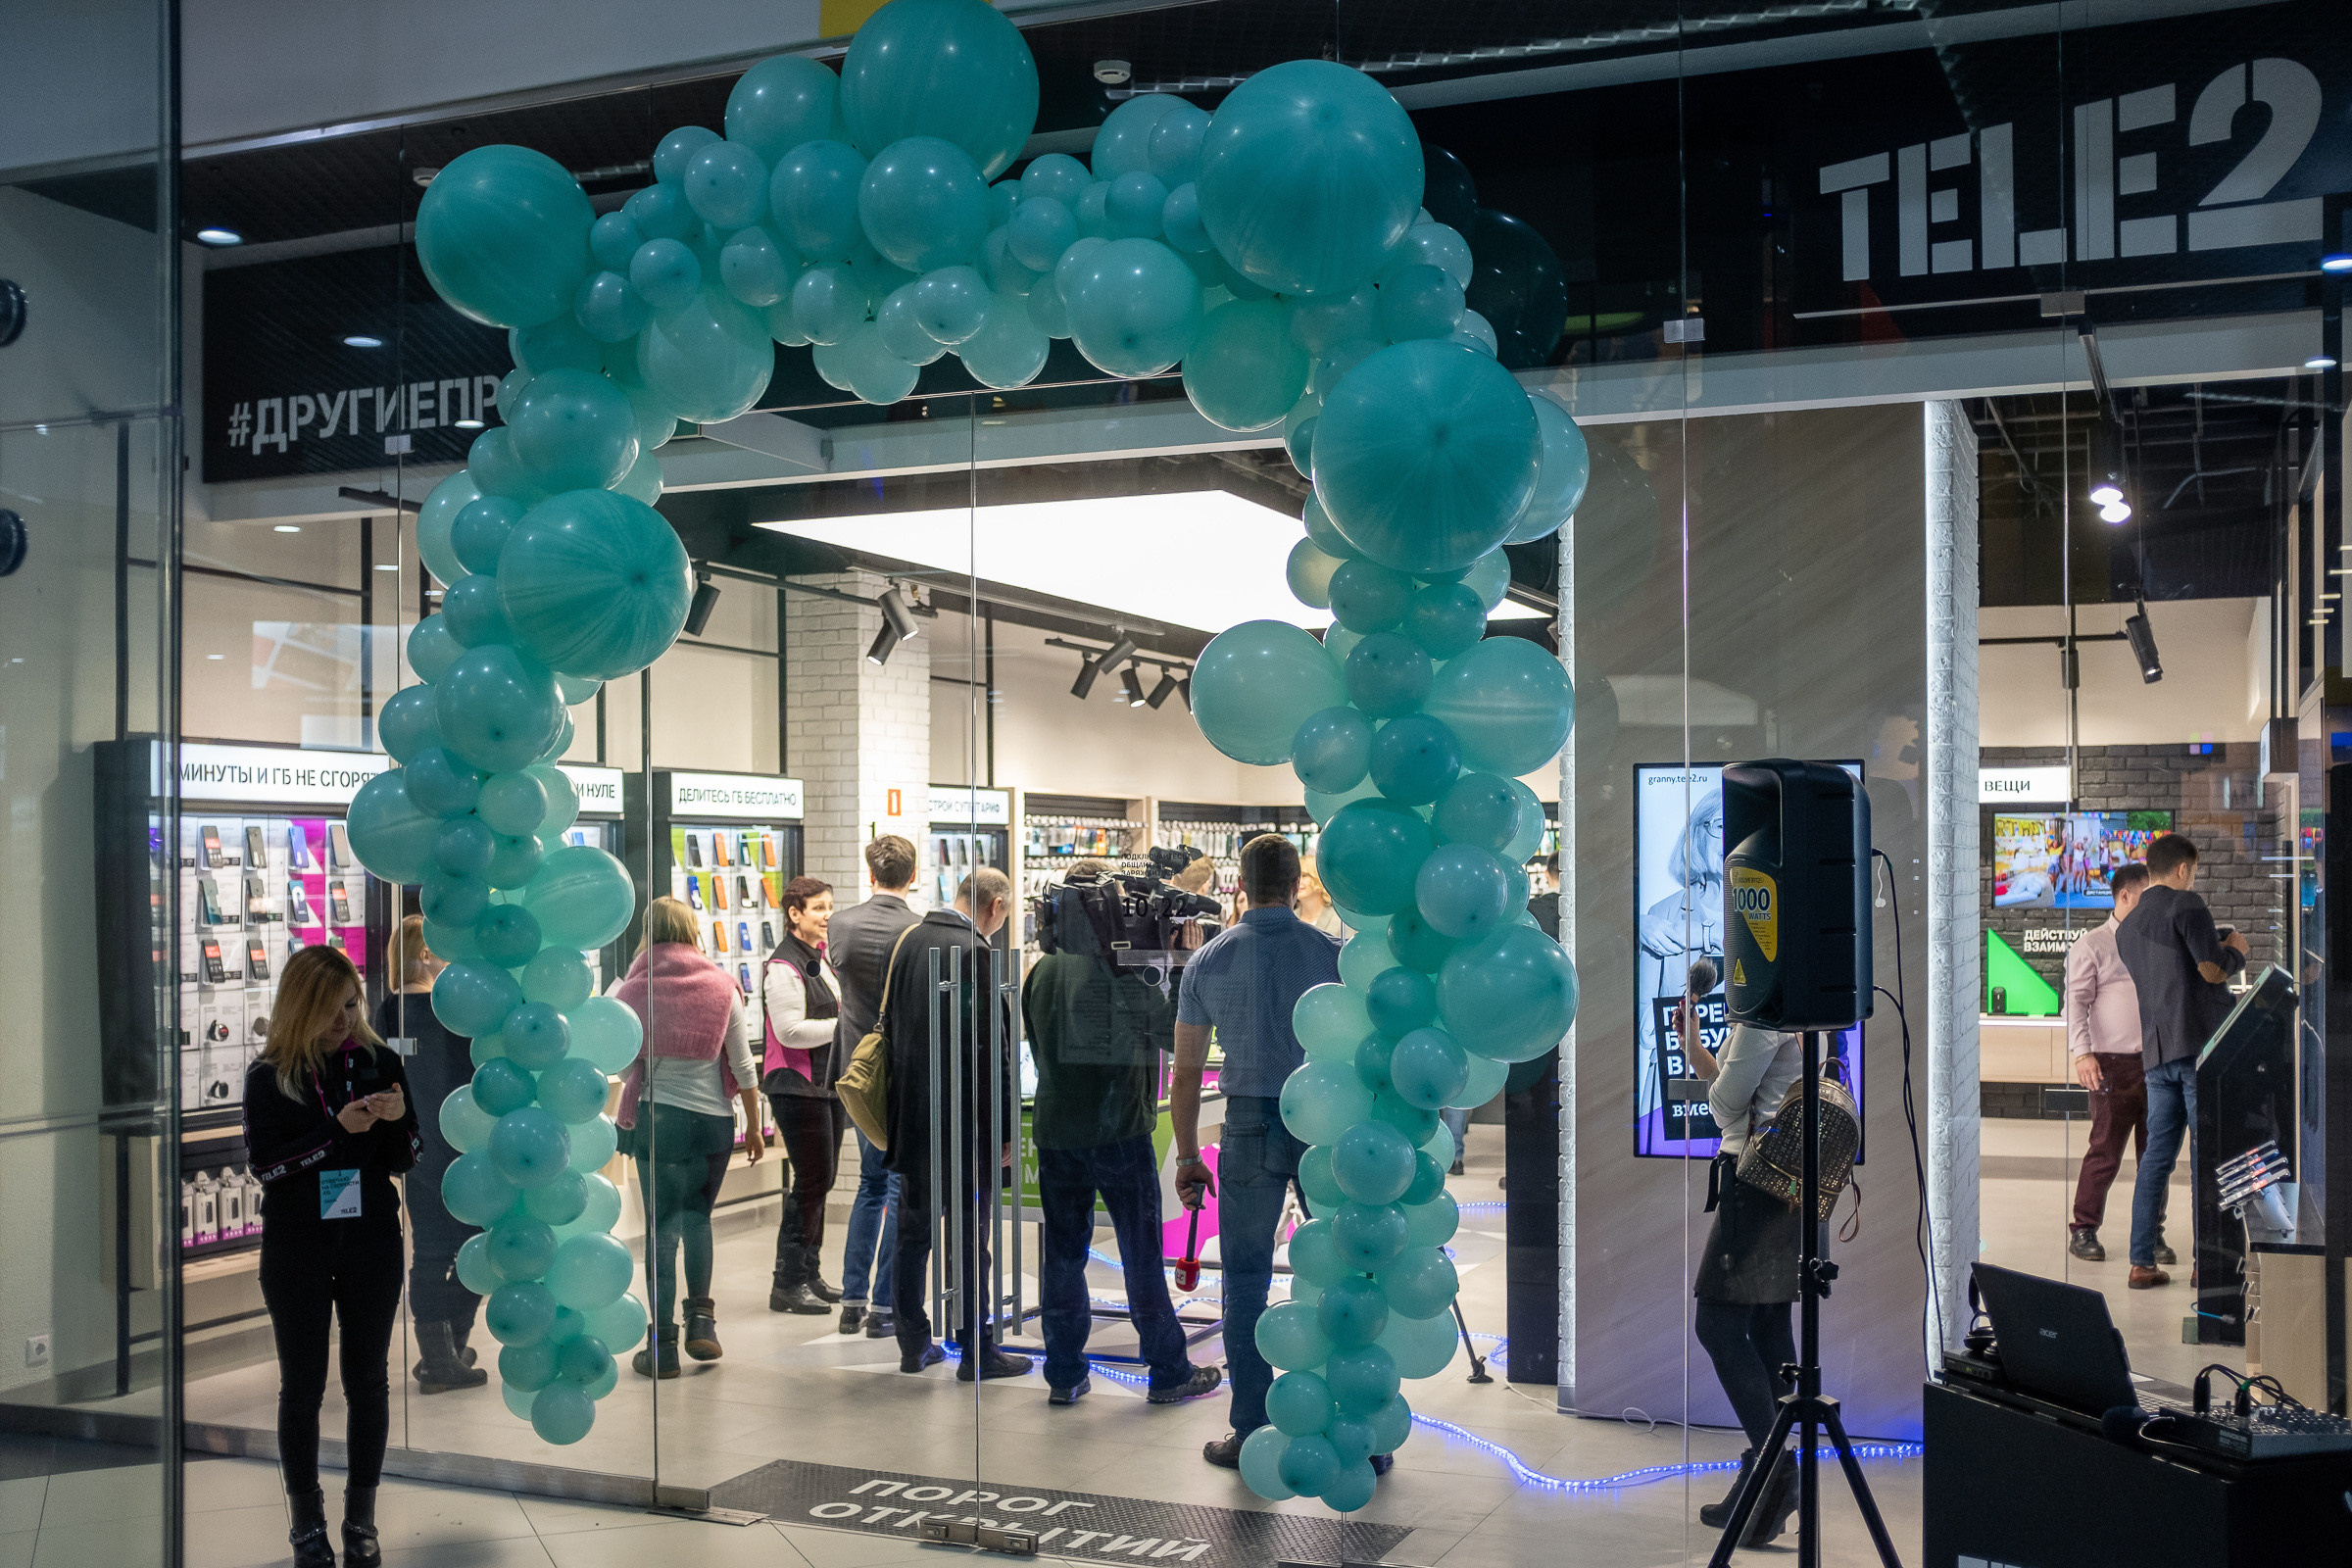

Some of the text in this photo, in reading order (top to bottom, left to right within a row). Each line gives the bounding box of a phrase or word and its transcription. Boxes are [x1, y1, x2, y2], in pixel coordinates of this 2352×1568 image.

[1819, 57, 2325, 282] TELE2
[257, 766, 268, 784] И
[272, 767, 291, 785] ГБ
[296, 768, 317, 787] НЕ
[1647, 773, 1708, 786] granny.tee2.ru
[587, 783, 615, 799] НУЛЕ
[1984, 780, 2031, 793] ВЕЩИ
[679, 787, 797, 807] ДЕЛИТЕСЬ ГБ БЕСПЛАТНО
[1733, 887, 1771, 912] 1000
[1748, 912, 1771, 921] WATTS
[1665, 1026, 1732, 1051] ББУ
[300, 1150, 326, 1167] TELE2
[261, 1164, 287, 1182] TELE2
[2039, 1328, 2058, 1339] acer
[849, 1479, 1096, 1516] ПОРОГ
